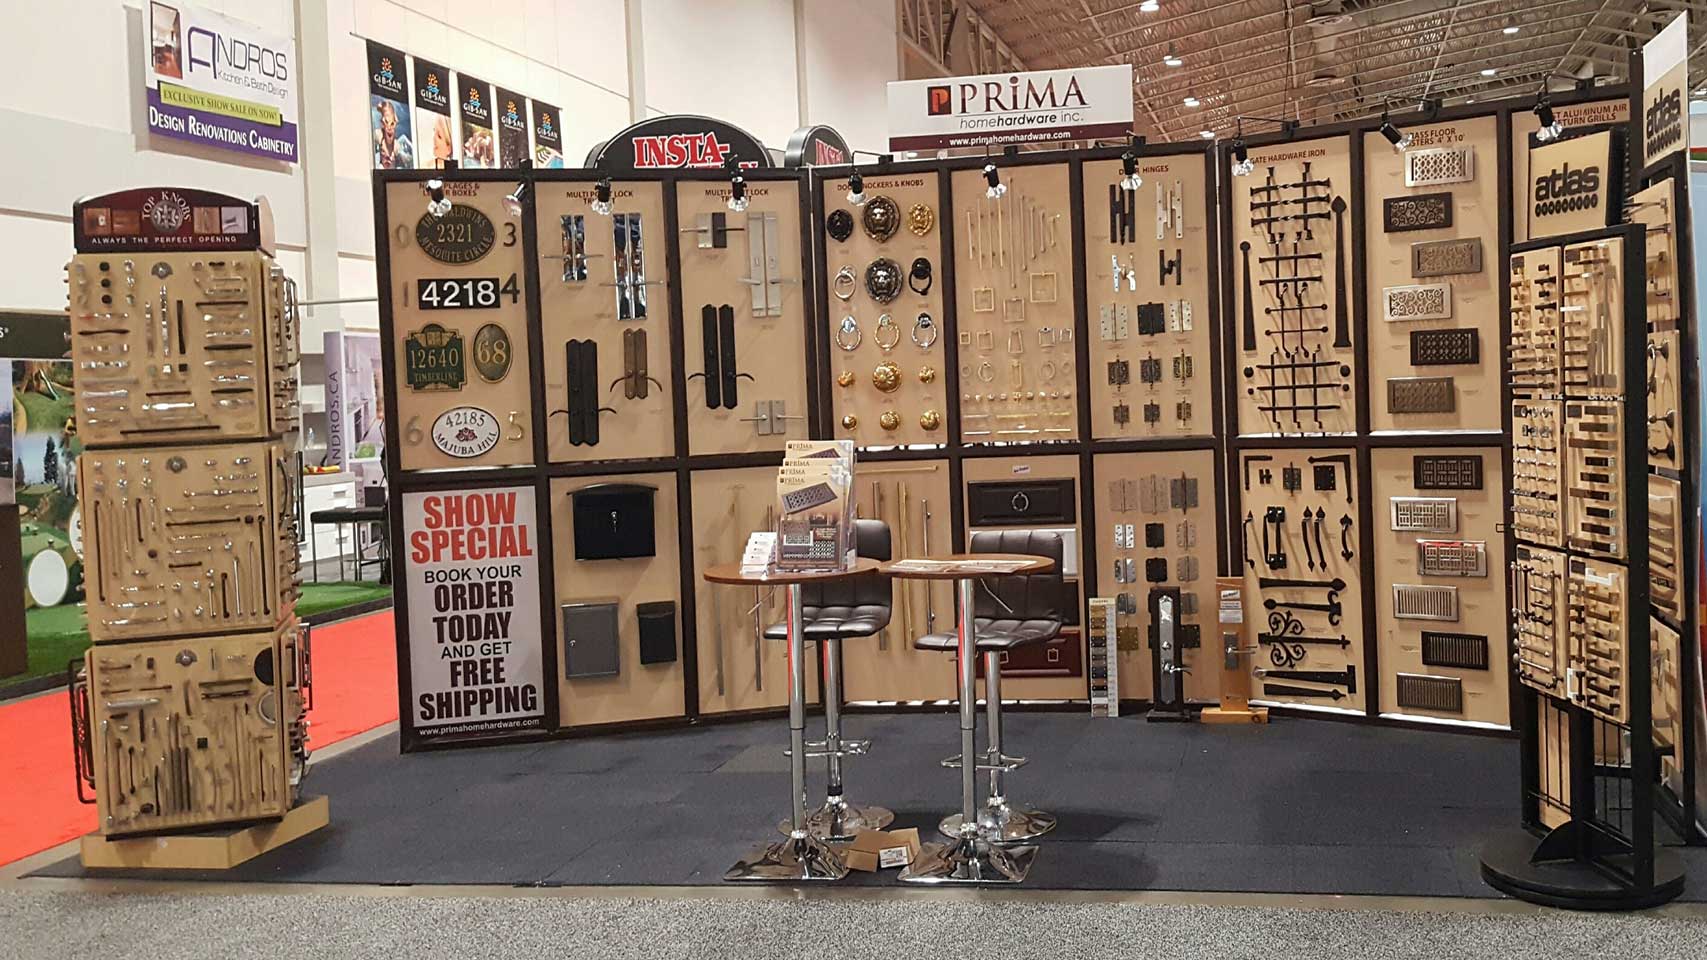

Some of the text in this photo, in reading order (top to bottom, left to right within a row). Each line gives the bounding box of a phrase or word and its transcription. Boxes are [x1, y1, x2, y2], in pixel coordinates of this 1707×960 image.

[188, 26, 287, 81] ANDROS
[374, 73, 402, 91] GIB-SAN
[163, 90, 204, 106] EXCLUSIVE
[207, 98, 230, 111] SHOW
[230, 102, 246, 114] SALE
[248, 107, 258, 117] ON
[420, 89, 447, 104] GIB-SAN
[463, 102, 488, 117] GIB-SAN
[1563, 105, 1610, 118] ALUMINUM
[1613, 104, 1627, 112] AIR
[1588, 113, 1616, 123] GRILLS
[1647, 88, 1682, 140] atlas
[501, 116, 525, 129] GIB-SAN
[960, 111, 1084, 129] homehardware inc.
[537, 127, 558, 140] GIB-SAN
[950, 131, 1071, 145] www.primahomehardware.com
[1431, 128, 1456, 137] FLOOR
[1251, 149, 1325, 164] GATE HARDWARE IRON
[1143, 165, 1168, 173] HINGES
[863, 181, 893, 190] NOCKERS
[901, 179, 924, 187] KNOBS
[1535, 162, 1600, 202] atlas
[614, 190, 633, 198] LOCK
[705, 189, 727, 197] MULTI
[142, 191, 192, 220] TOP KNOBS
[437, 223, 472, 243] 2321
[503, 222, 517, 247] 3
[421, 280, 496, 307] 4218
[500, 272, 520, 304] 4
[410, 348, 459, 369] 12640
[477, 340, 507, 364] 68
[445, 411, 485, 428] 42185
[435, 431, 498, 455] MAJUBA HILL
[423, 492, 517, 530] SHOW
[411, 525, 533, 564] SPECIAL
[425, 565, 522, 583] BOOK YOUR
[434, 580, 514, 612] ORDER
[433, 611, 512, 643] TODAY
[441, 642, 512, 659] AND GET
[450, 657, 506, 688] FREE
[419, 684, 537, 721] SHIPPING
[420, 717, 540, 736] www.primahomehardware.com
